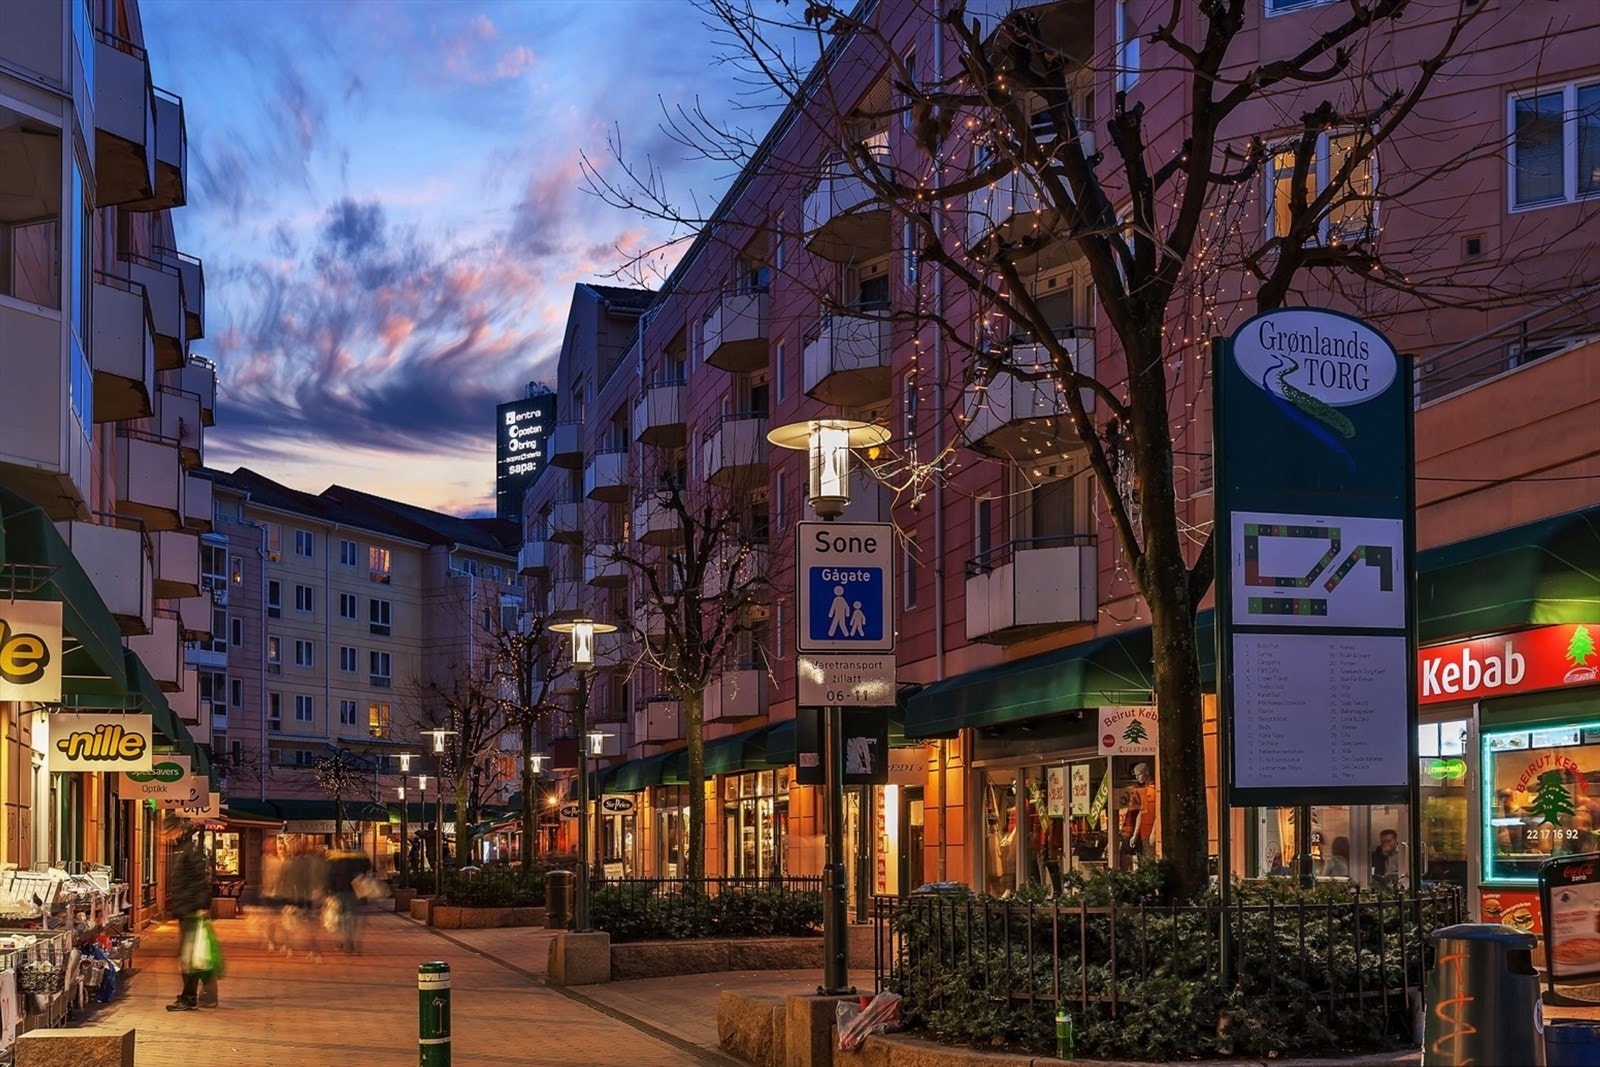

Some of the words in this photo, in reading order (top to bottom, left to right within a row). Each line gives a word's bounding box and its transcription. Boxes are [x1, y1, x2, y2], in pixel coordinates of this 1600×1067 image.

[1259, 320, 1369, 360] Grønlands
[1304, 358, 1370, 392] TORG
[815, 531, 877, 554] Sone
[822, 569, 871, 585] Gågate
[812, 660, 883, 671] Varetransport
[1422, 641, 1526, 697] Kebab
[833, 675, 861, 683] tillatt
[1104, 709, 1135, 727] Beirut
[1139, 708, 1159, 722] Keb
[888, 764, 923, 772] EDI's
[1516, 755, 1551, 793] BEIRUT
[142, 785, 167, 793] Optikk
[1527, 830, 1538, 839] 22
[1541, 829, 1550, 839] 17
[1554, 829, 1563, 839] 16
[1566, 829, 1578, 839] 92
